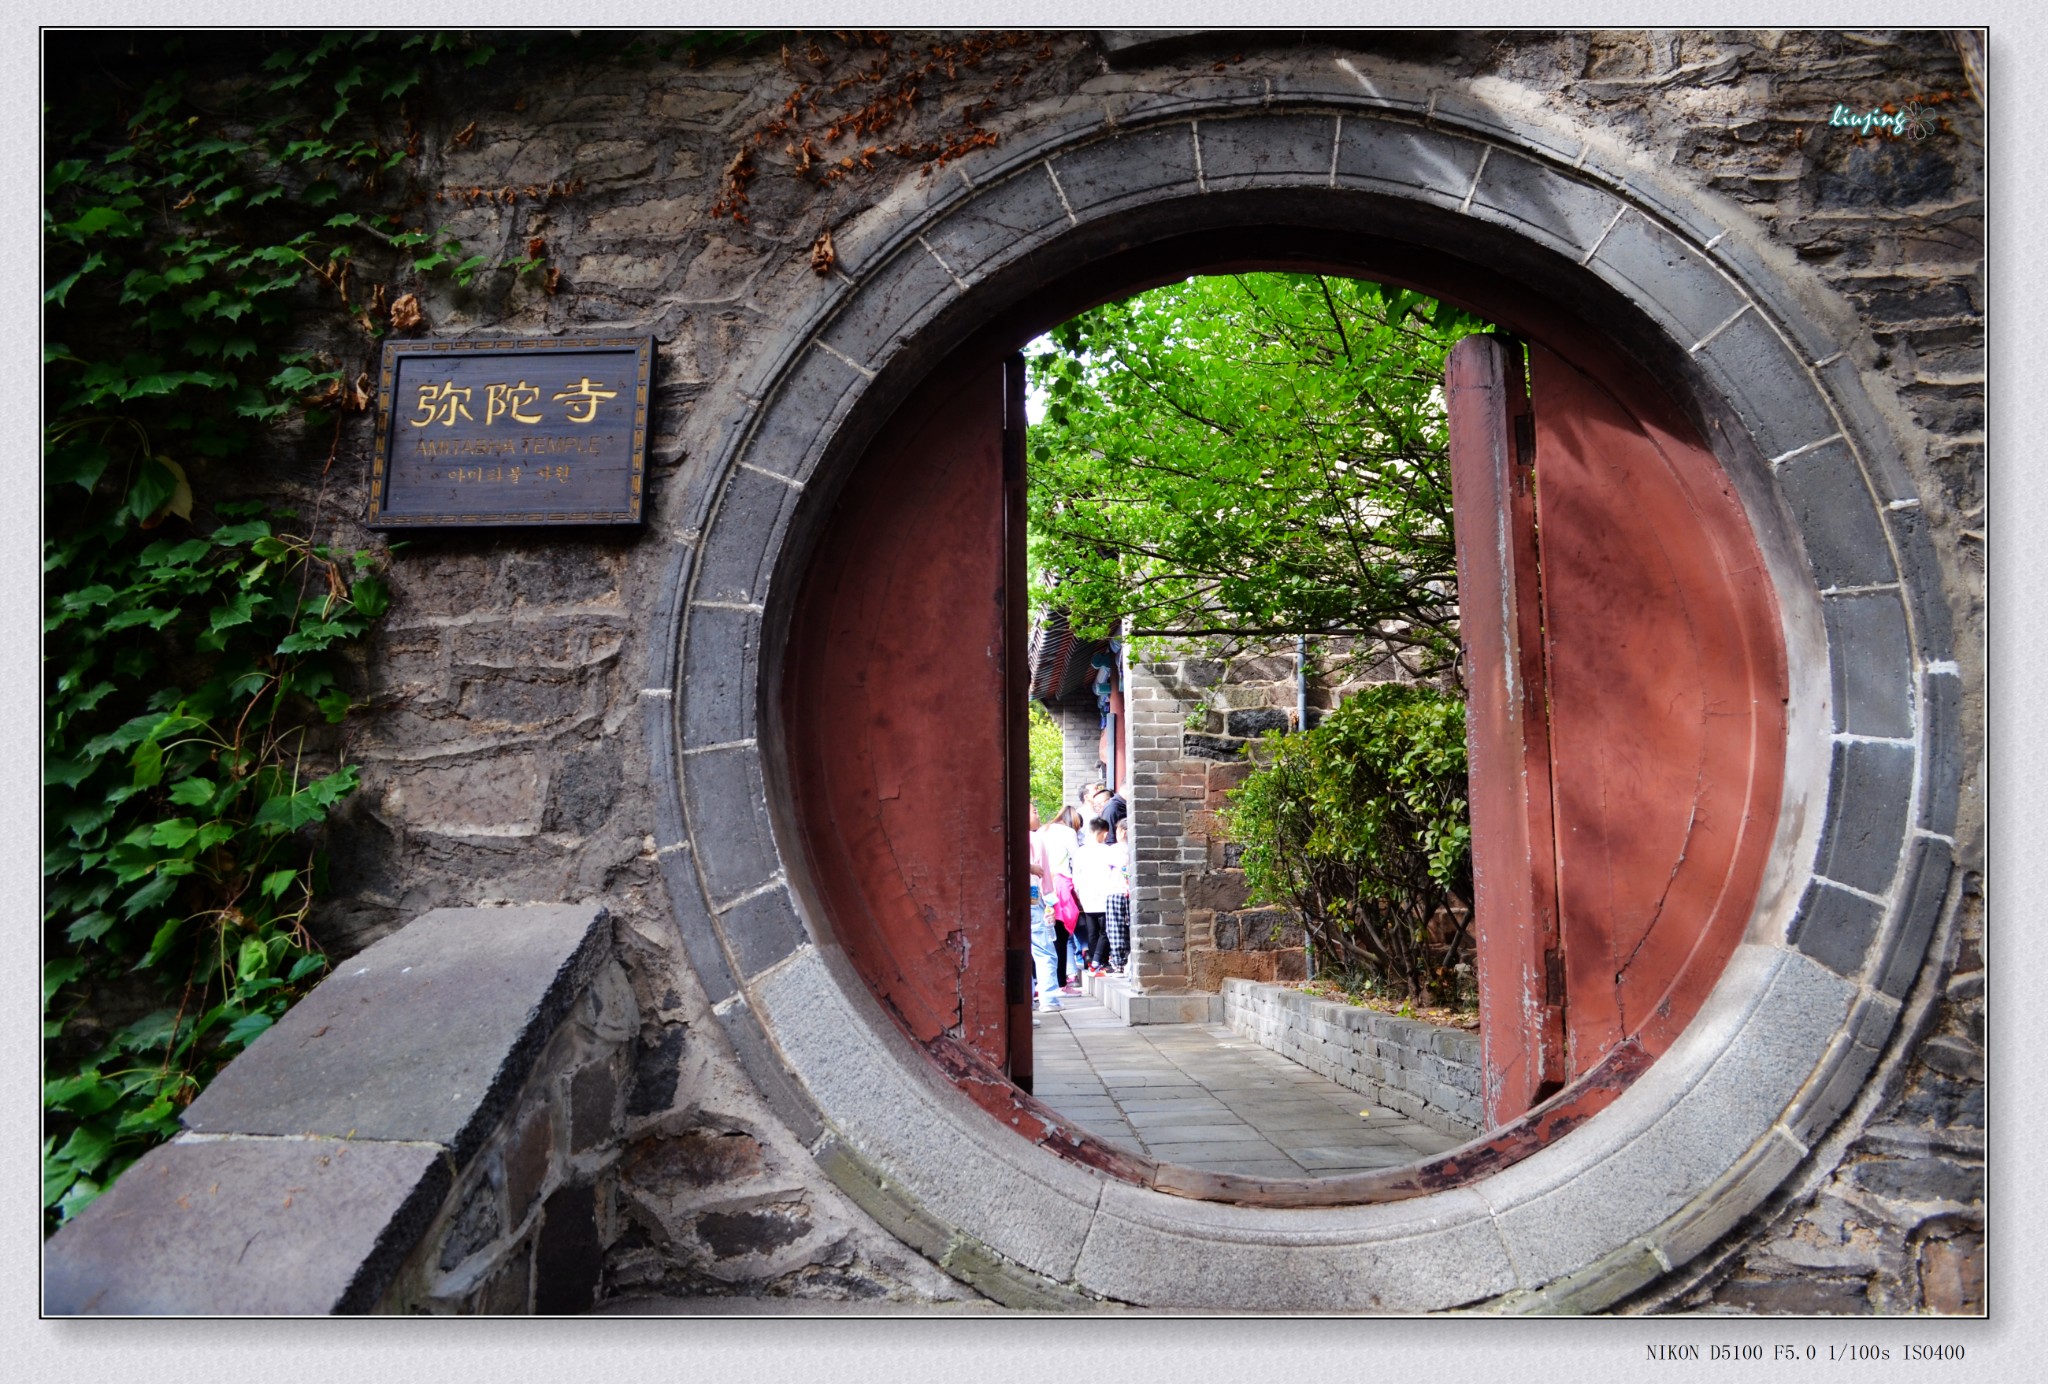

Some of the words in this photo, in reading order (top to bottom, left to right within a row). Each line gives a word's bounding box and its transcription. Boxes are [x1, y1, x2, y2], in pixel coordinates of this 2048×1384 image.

[410, 377, 617, 427] 弥陀寺
[521, 436, 601, 454] TEMPLE
